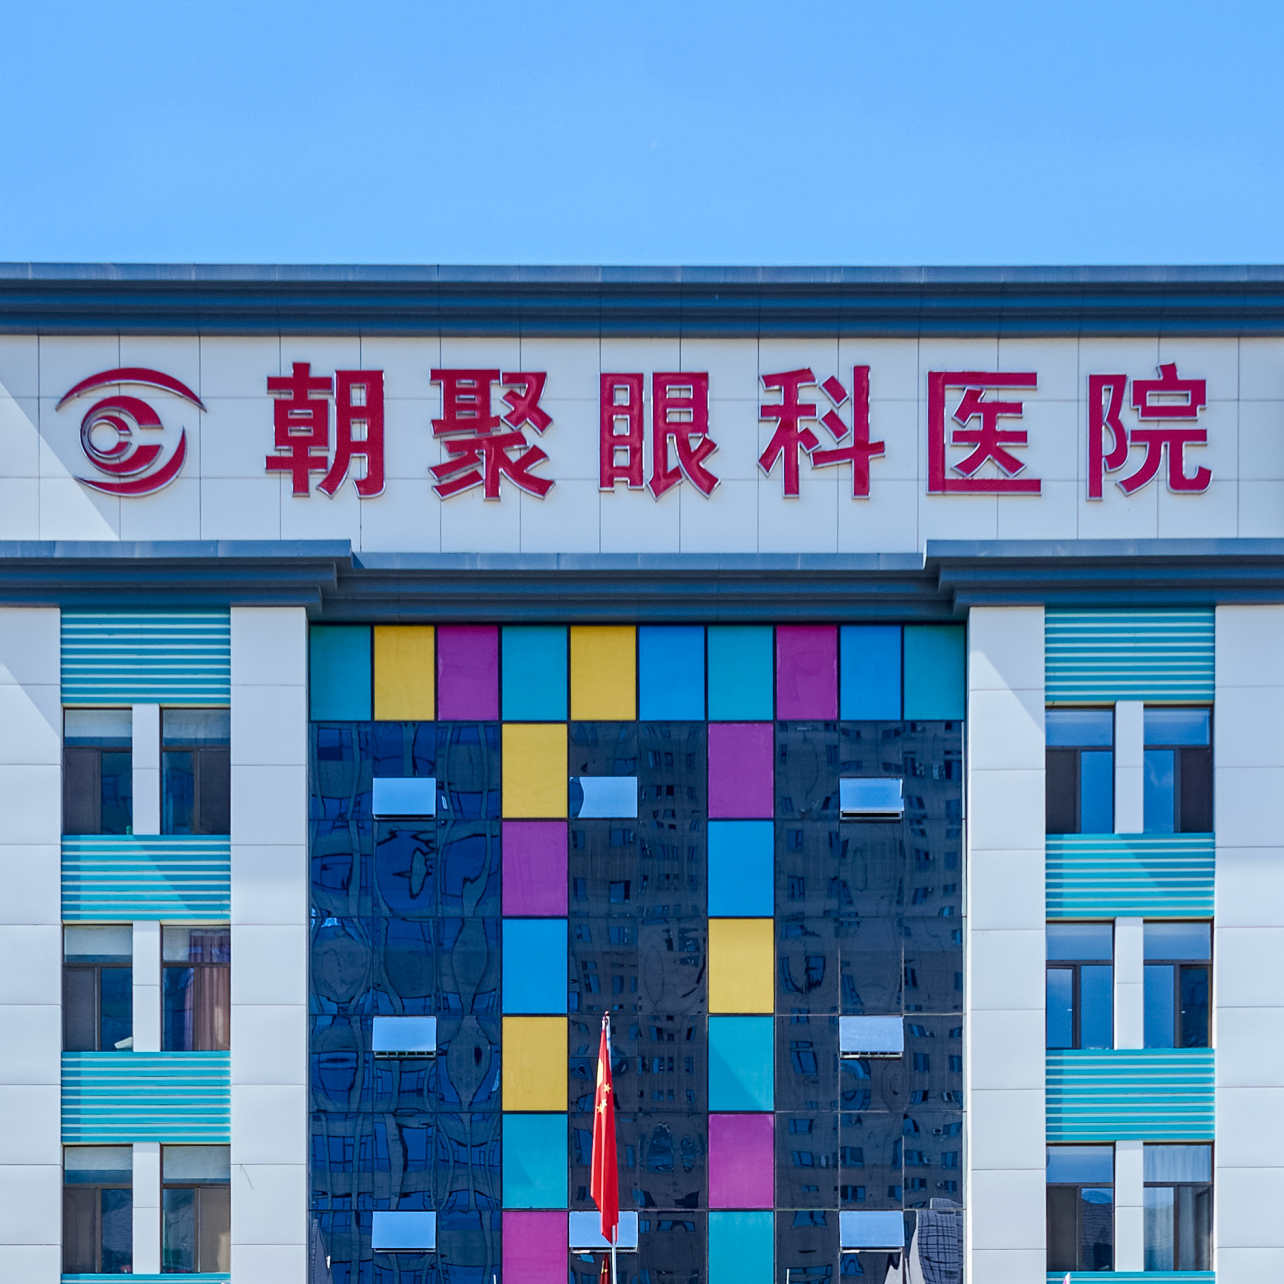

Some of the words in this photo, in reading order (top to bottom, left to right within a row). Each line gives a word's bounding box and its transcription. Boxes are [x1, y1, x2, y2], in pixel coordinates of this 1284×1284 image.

[264, 361, 1214, 501] 朝聚眼科医院
